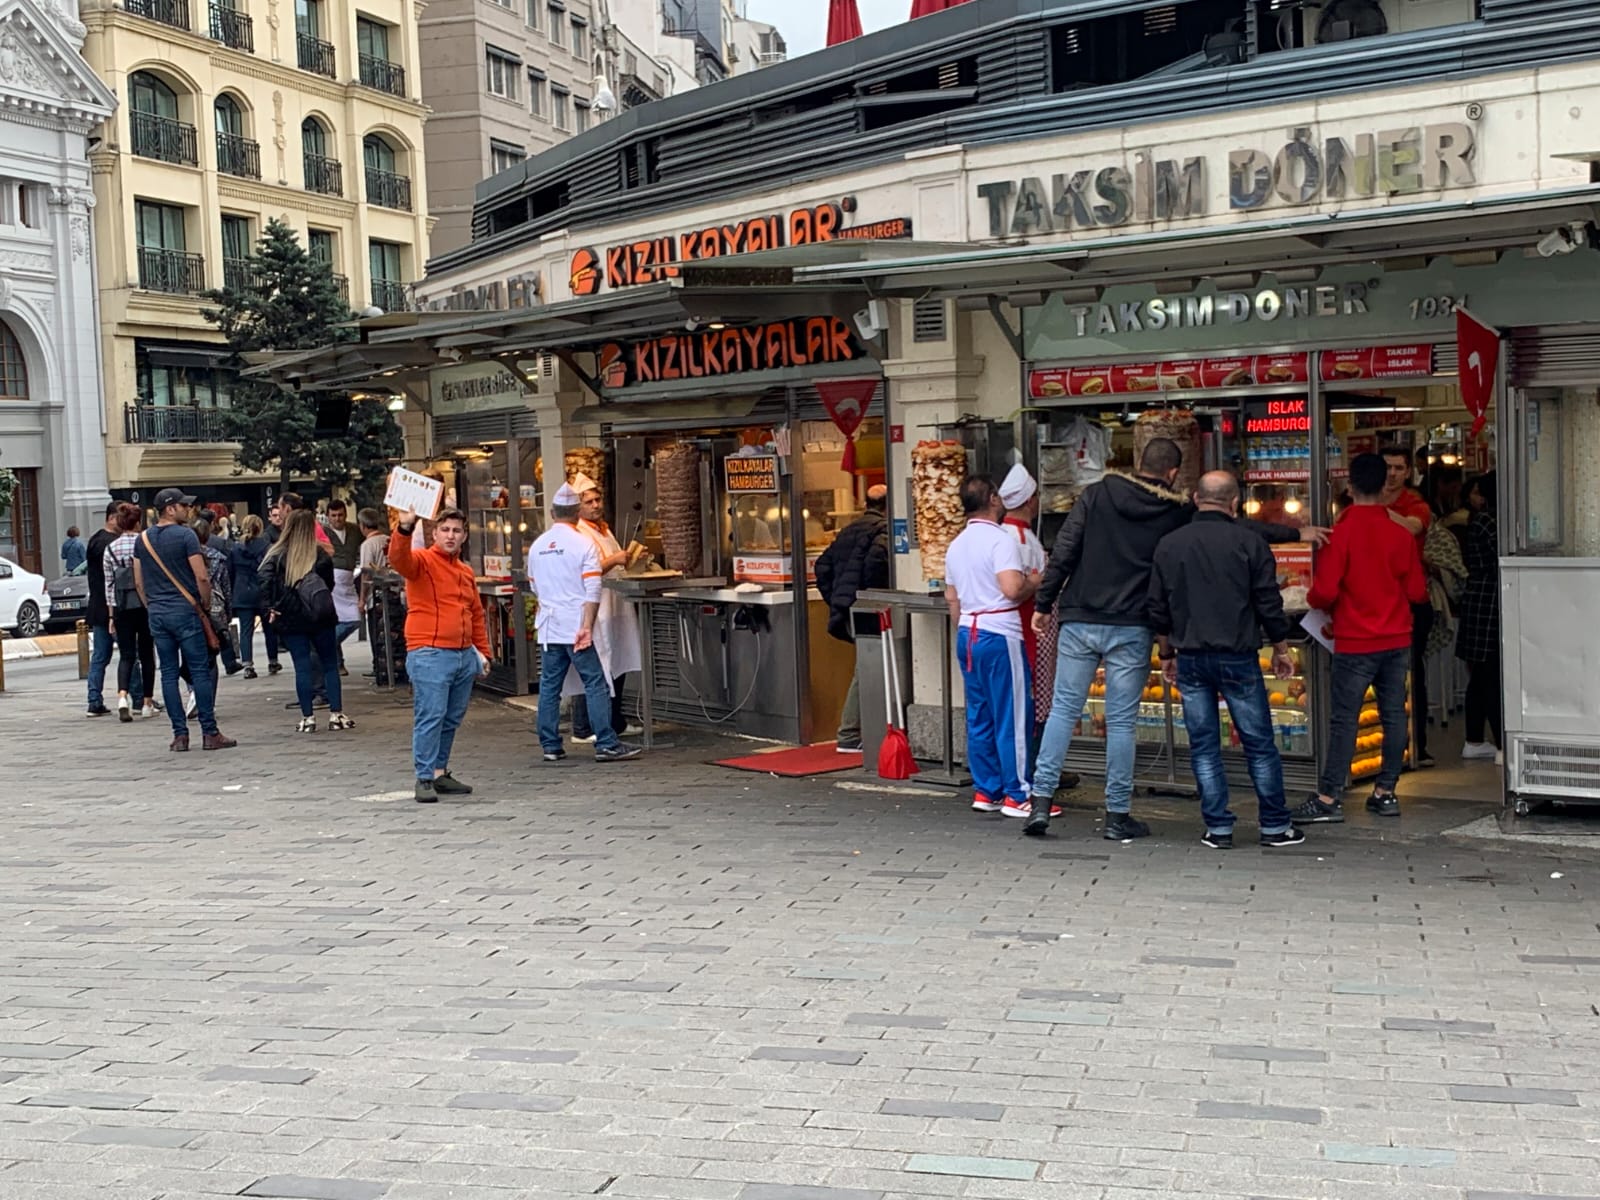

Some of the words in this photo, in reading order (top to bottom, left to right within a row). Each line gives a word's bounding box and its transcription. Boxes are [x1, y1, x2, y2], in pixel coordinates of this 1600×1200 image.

[978, 152, 1206, 237] TAKSİM
[1229, 122, 1476, 210] DÖNER
[838, 219, 905, 240] HAMBURGER
[635, 315, 854, 382] KIZILKAYALAR
[1388, 359, 1412, 368] ISLAK
[1268, 400, 1304, 415] ISLAK
[730, 474, 775, 489] HAMBURGER
[1249, 471, 1272, 480] ISLAK
